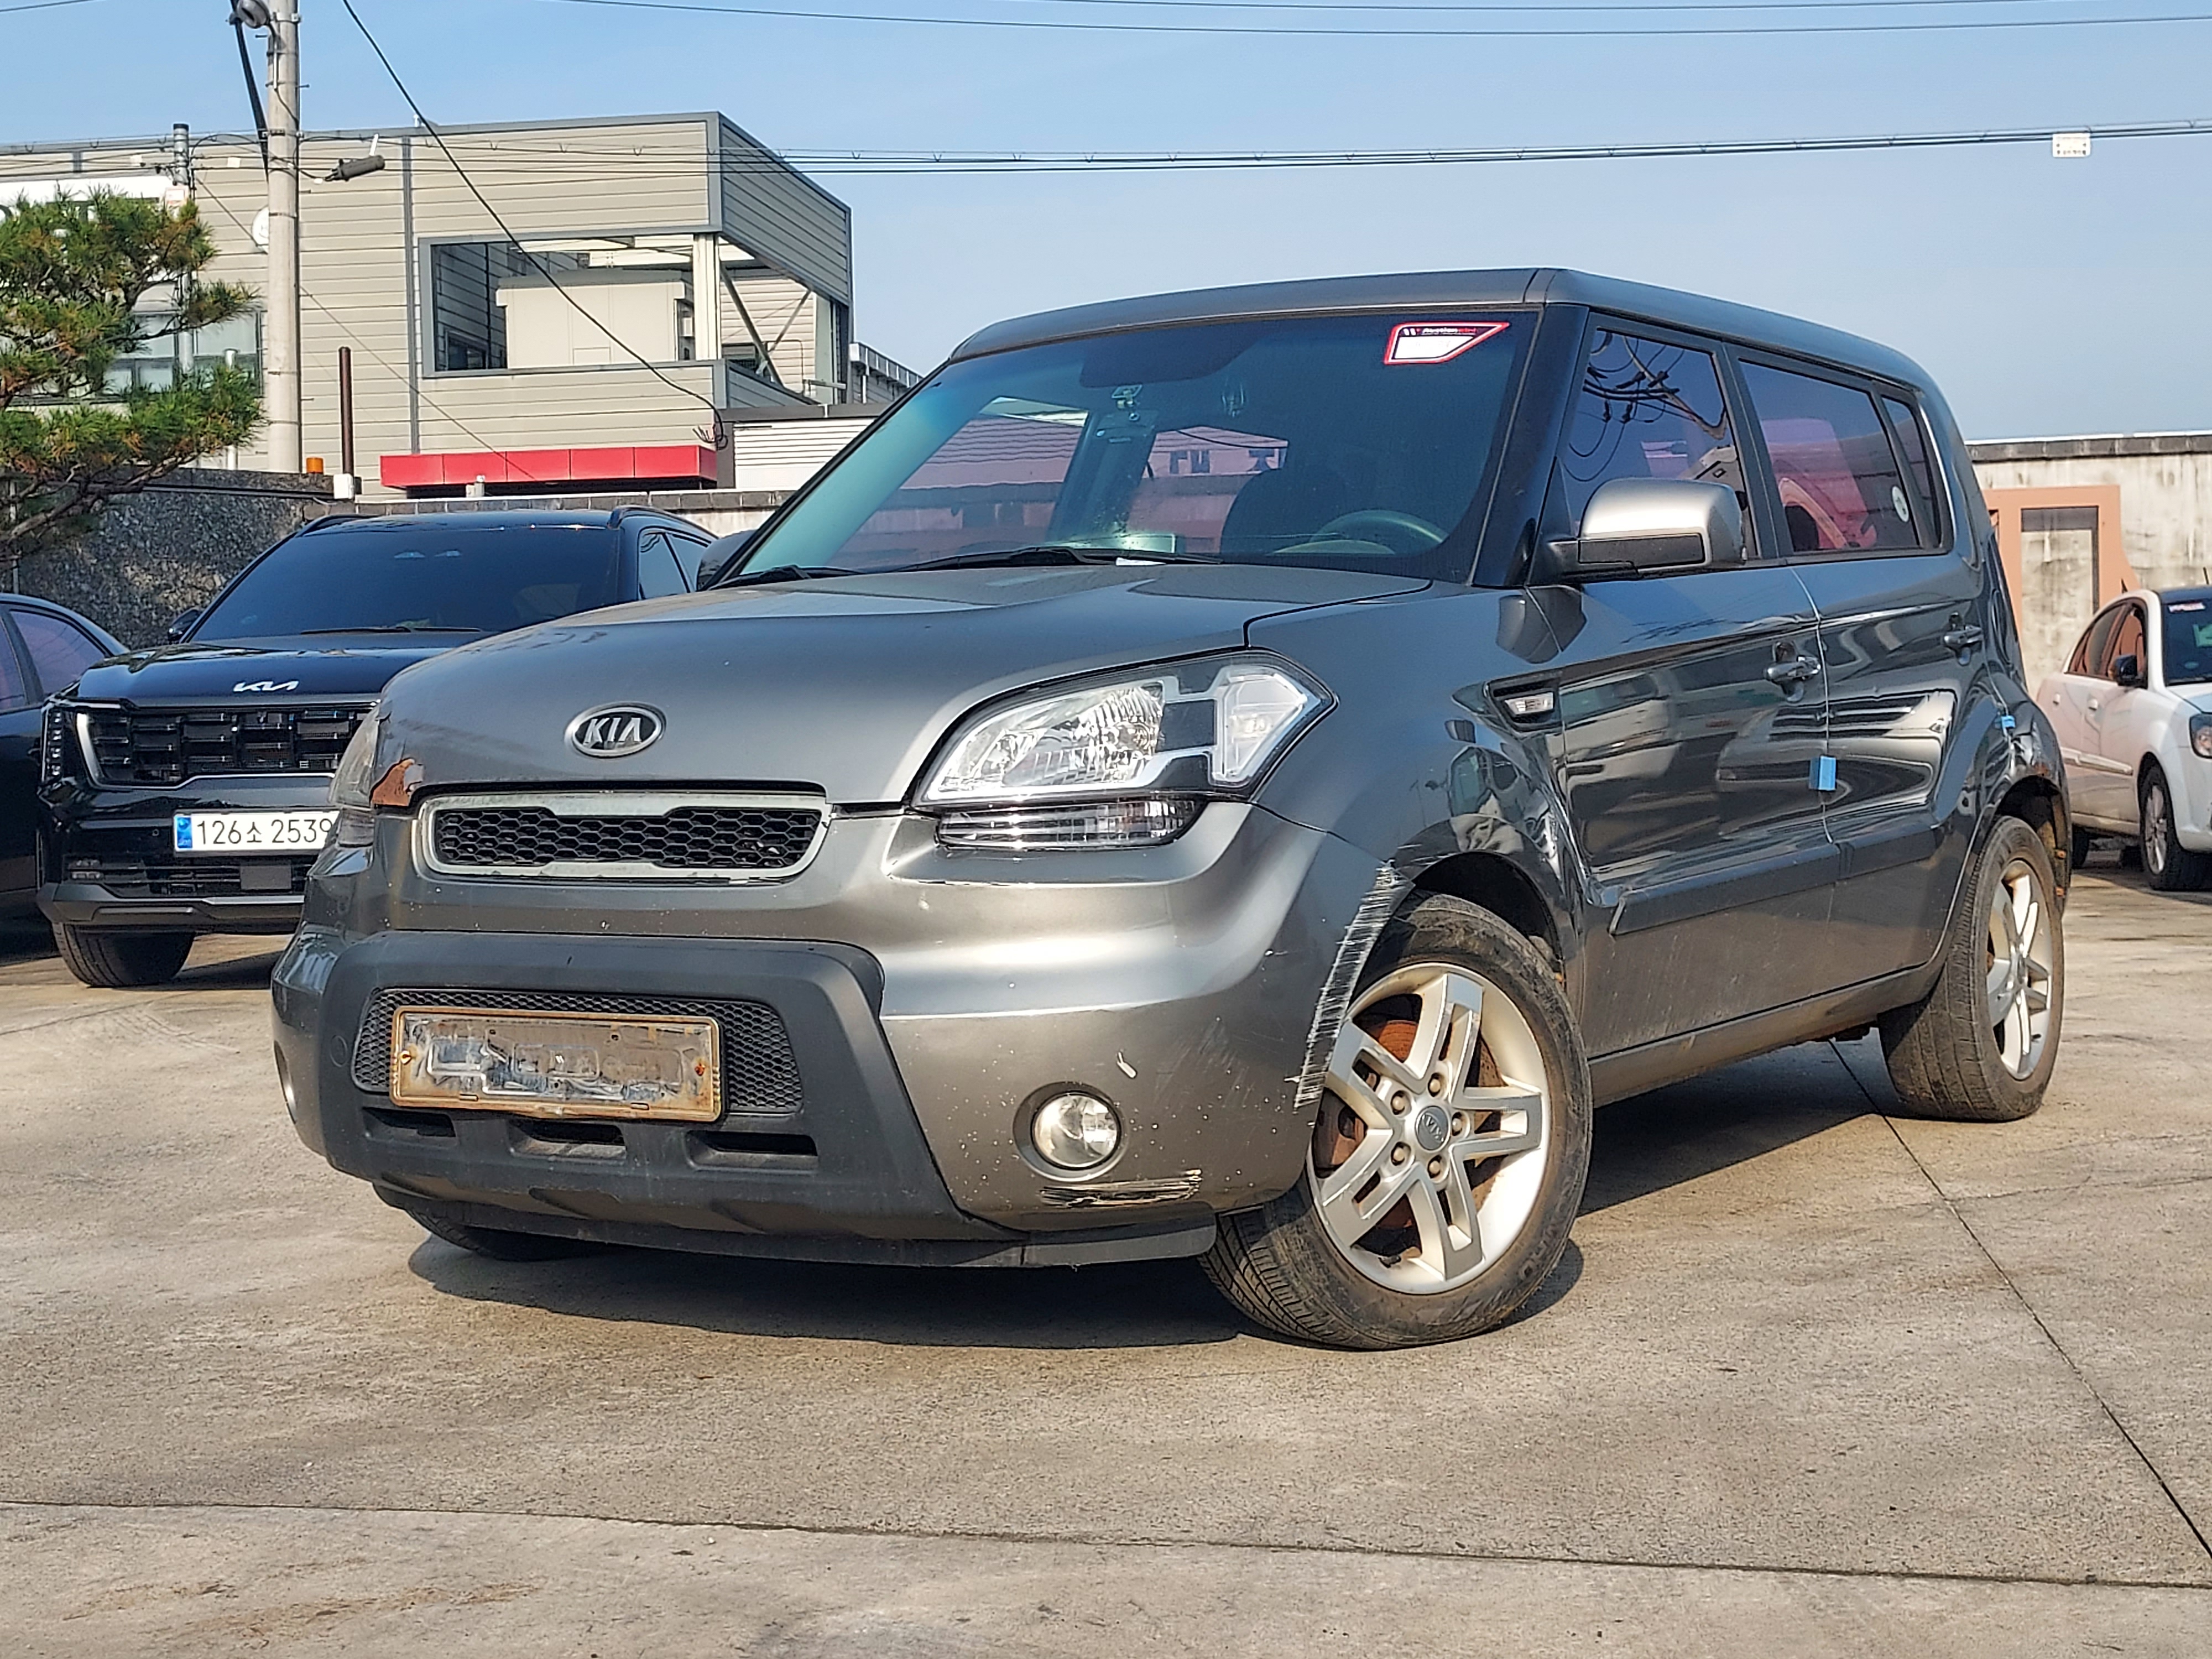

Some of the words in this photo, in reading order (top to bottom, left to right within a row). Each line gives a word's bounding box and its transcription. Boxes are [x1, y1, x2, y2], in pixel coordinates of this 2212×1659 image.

[583, 717, 641, 744] KIA
[196, 820, 262, 845] 126소
[270, 818, 332, 843] 2539
